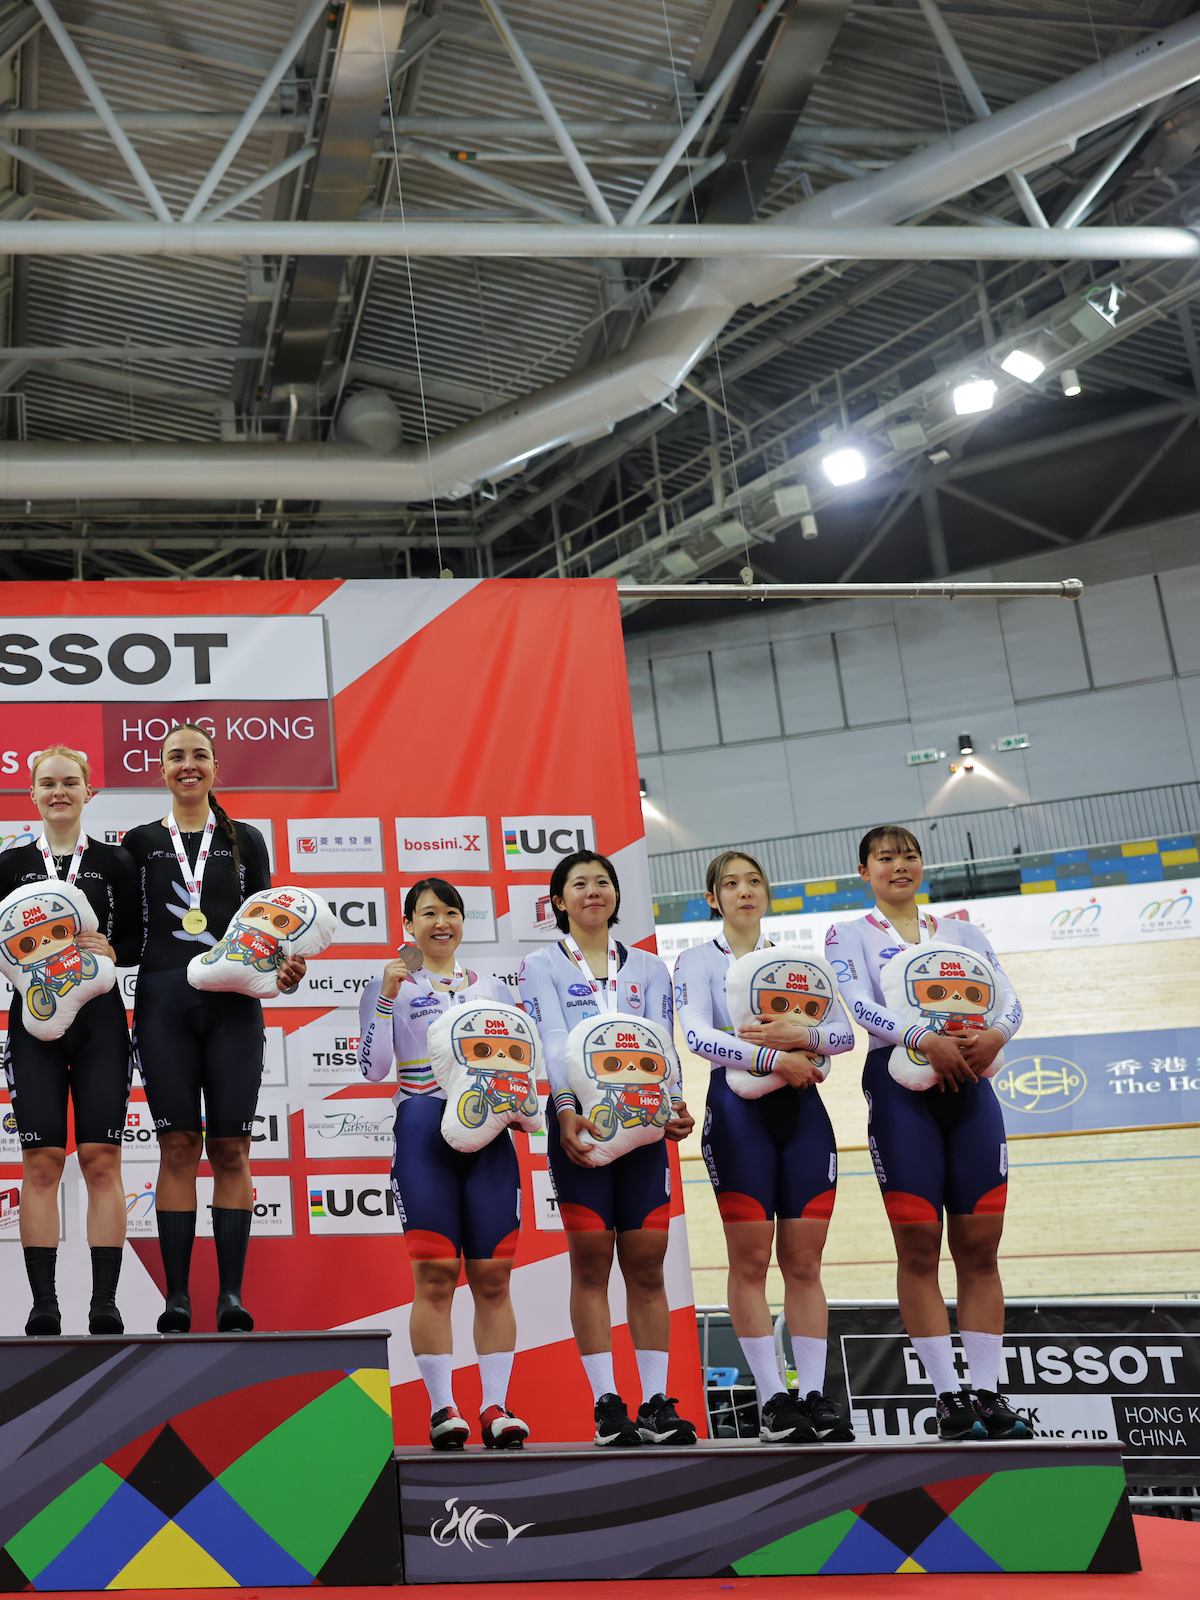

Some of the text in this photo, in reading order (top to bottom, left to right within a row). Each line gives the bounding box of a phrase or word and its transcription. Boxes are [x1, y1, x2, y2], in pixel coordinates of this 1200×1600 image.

[226, 716, 315, 741] KONG
[520, 829, 586, 854] UCI
[270, 898, 292, 909] DONG
[277, 893, 296, 903] DIN
[22, 905, 42, 920] DIN
[23, 913, 48, 927] DONG
[250, 941, 272, 956] HKG
[62, 955, 81, 969] HKG
[940, 962, 961, 970] DIN
[847, 959, 858, 980] KEIRIN
[939, 969, 966, 977] DONG
[788, 973, 807, 983] DIN
[786, 982, 809, 991] DONG
[854, 1001, 895, 1031] Cyclers
[485, 1020, 505, 1028] DIN
[484, 1028, 509, 1036] DONG
[617, 1033, 636, 1041] DIN
[615, 1041, 640, 1049] DONG
[686, 1030, 743, 1061] Cyclers
[509, 1083, 528, 1094] HKG
[1109, 1077, 1161, 1095] The
[639, 1097, 660, 1106] HKG
[702, 1143, 719, 1188] SPEED
[869, 1135, 887, 1184] SPEED
[326, 1189, 394, 1217] UCI
[1124, 1406, 1184, 1424] HONG
[1129, 1429, 1187, 1447] CHINA
